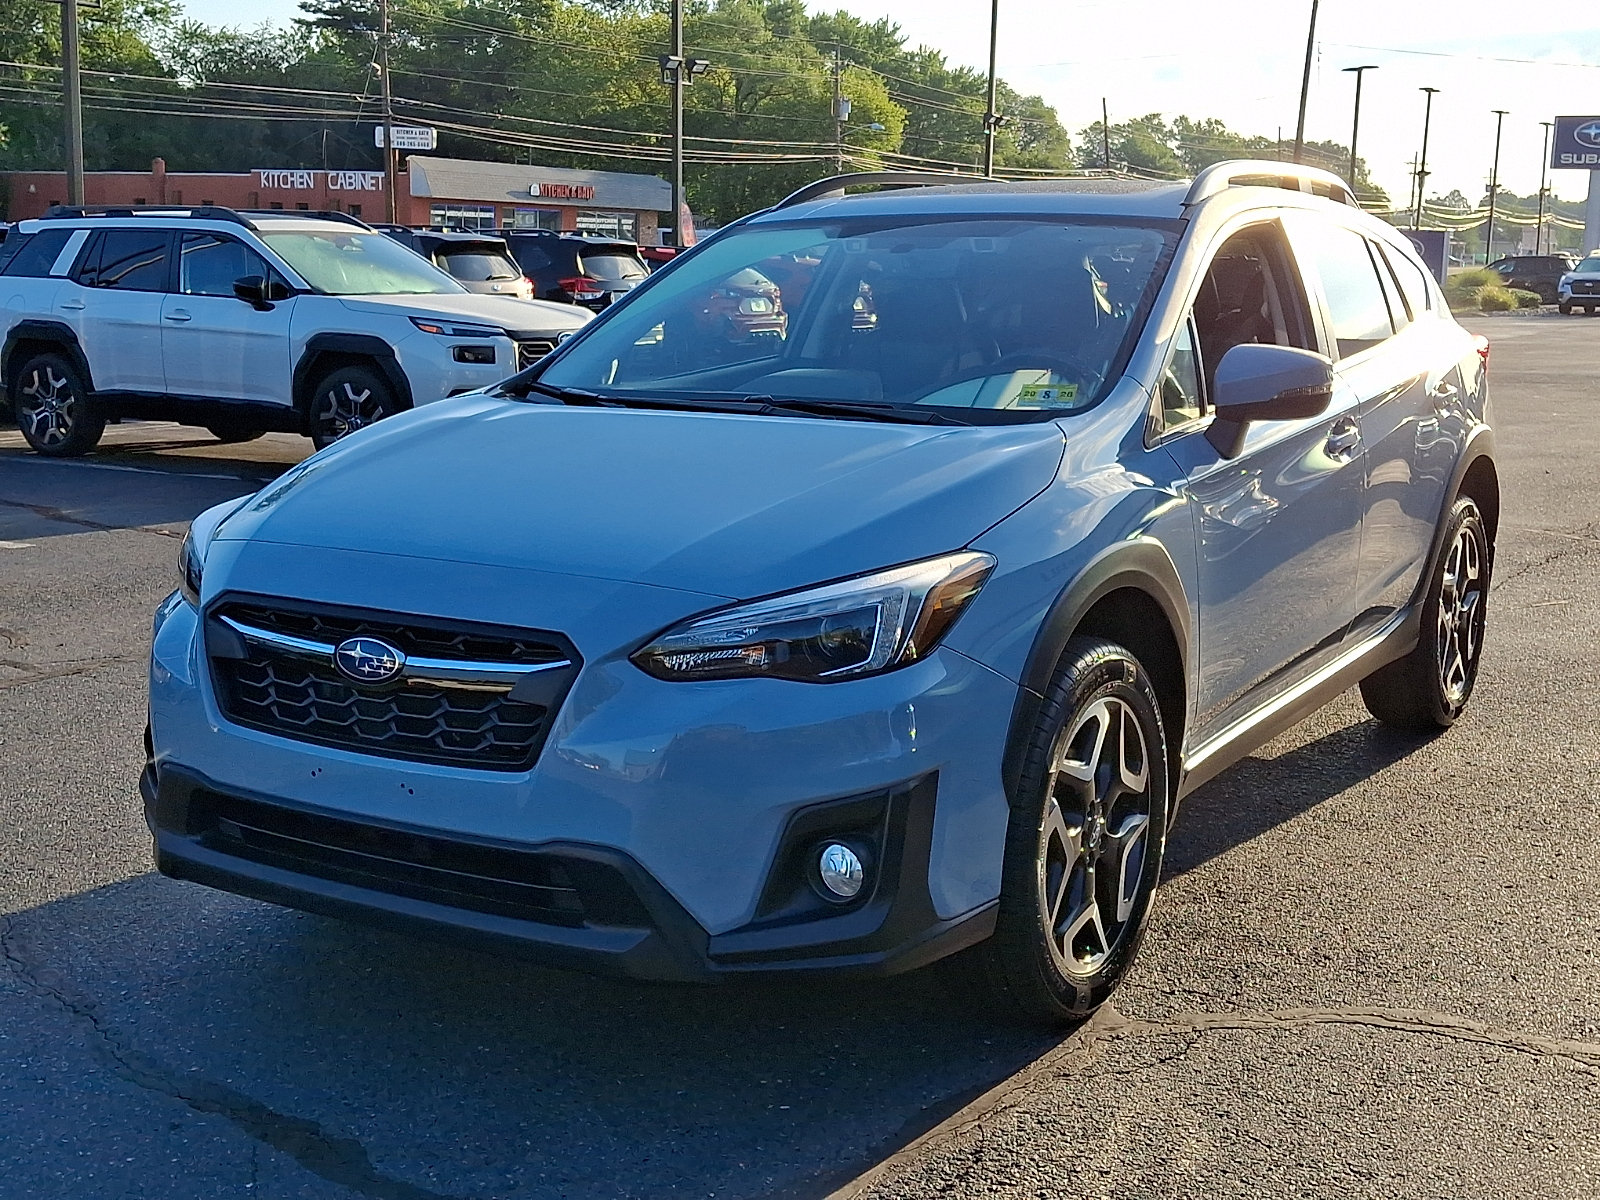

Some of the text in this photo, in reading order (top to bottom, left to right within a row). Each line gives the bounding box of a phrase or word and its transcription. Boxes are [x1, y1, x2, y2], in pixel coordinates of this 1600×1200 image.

[1560, 153, 1600, 164] SUB
[260, 171, 385, 191] KITCHEN CABINET
[540, 182, 595, 199] KITCHEN & BATH
[1042, 390, 1051, 399] 8
